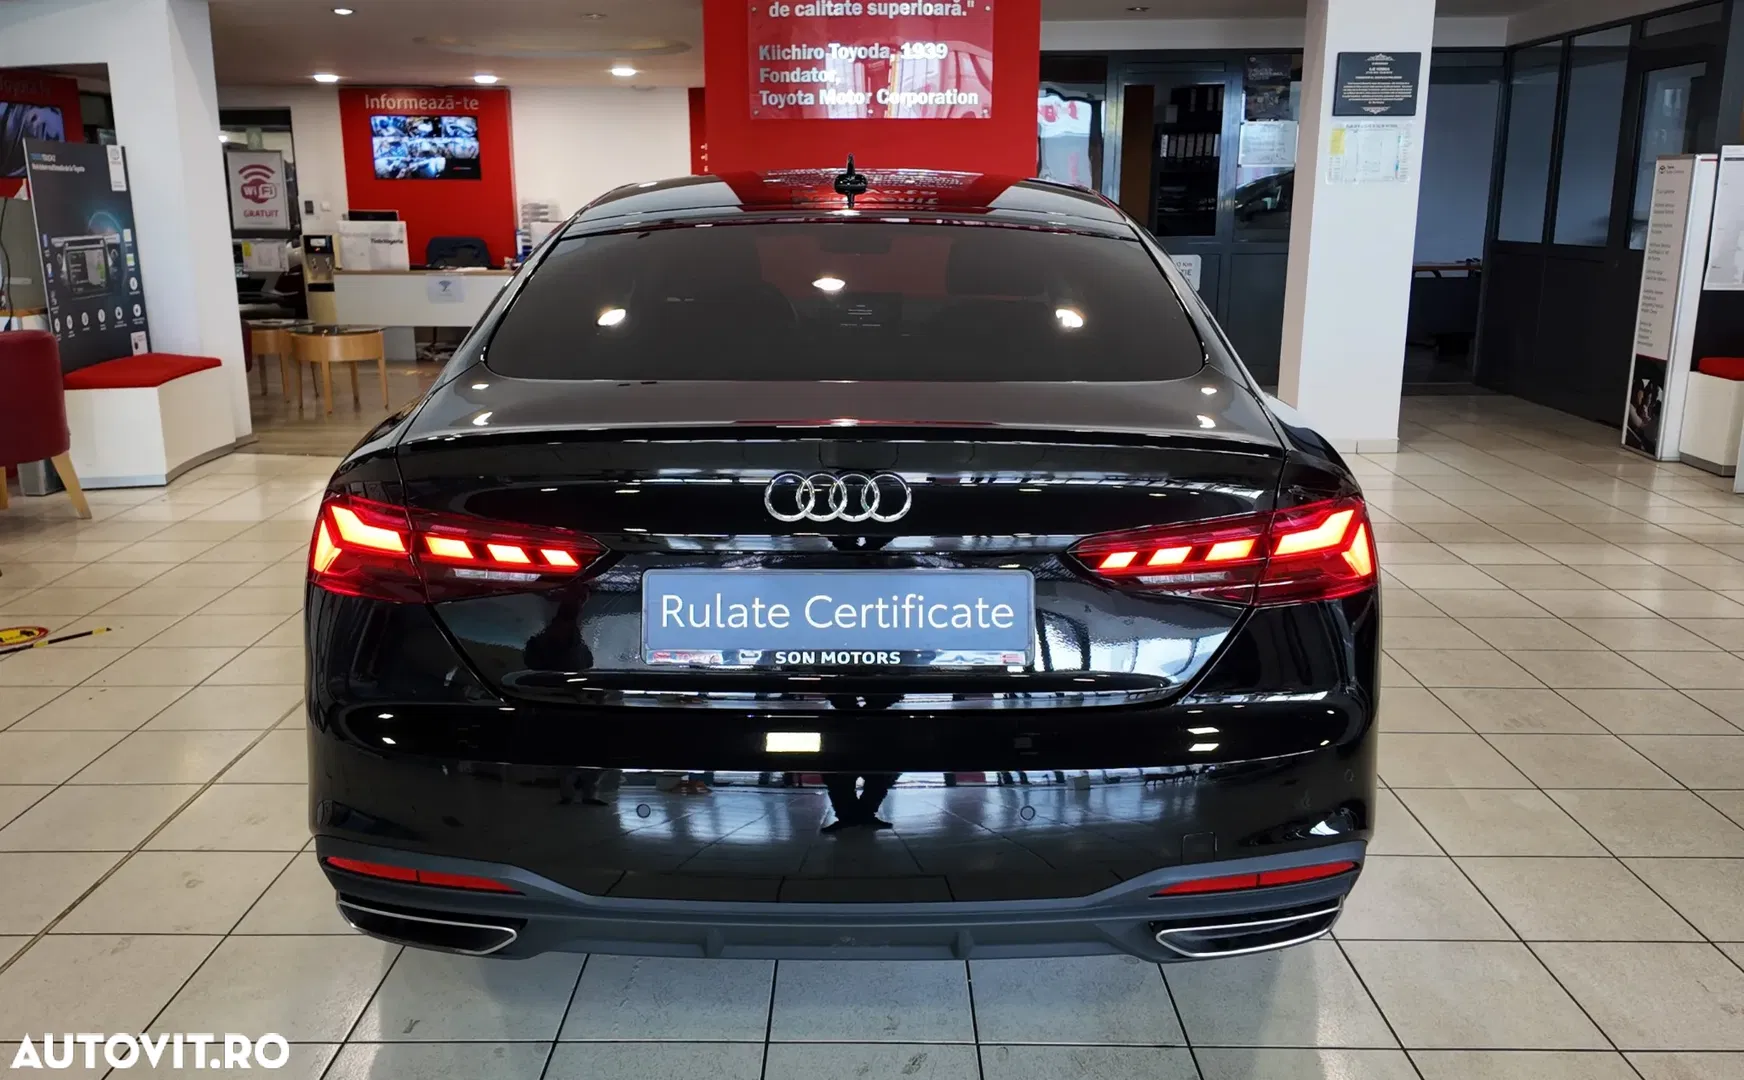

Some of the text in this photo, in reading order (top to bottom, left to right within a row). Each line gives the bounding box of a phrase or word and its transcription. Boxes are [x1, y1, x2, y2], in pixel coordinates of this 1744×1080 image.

[769, 1, 790, 17] de
[794, 0, 863, 17] calitate
[758, 44, 825, 61] Kiichiro
[900, 42, 948, 60] 1939
[759, 89, 979, 109] Toyota Motor Corporation
[243, 209, 279, 218] GRATUIT
[661, 593, 1014, 629] Rulate Certificate
[775, 651, 815, 664] SON
[820, 651, 901, 664] MOTORS
